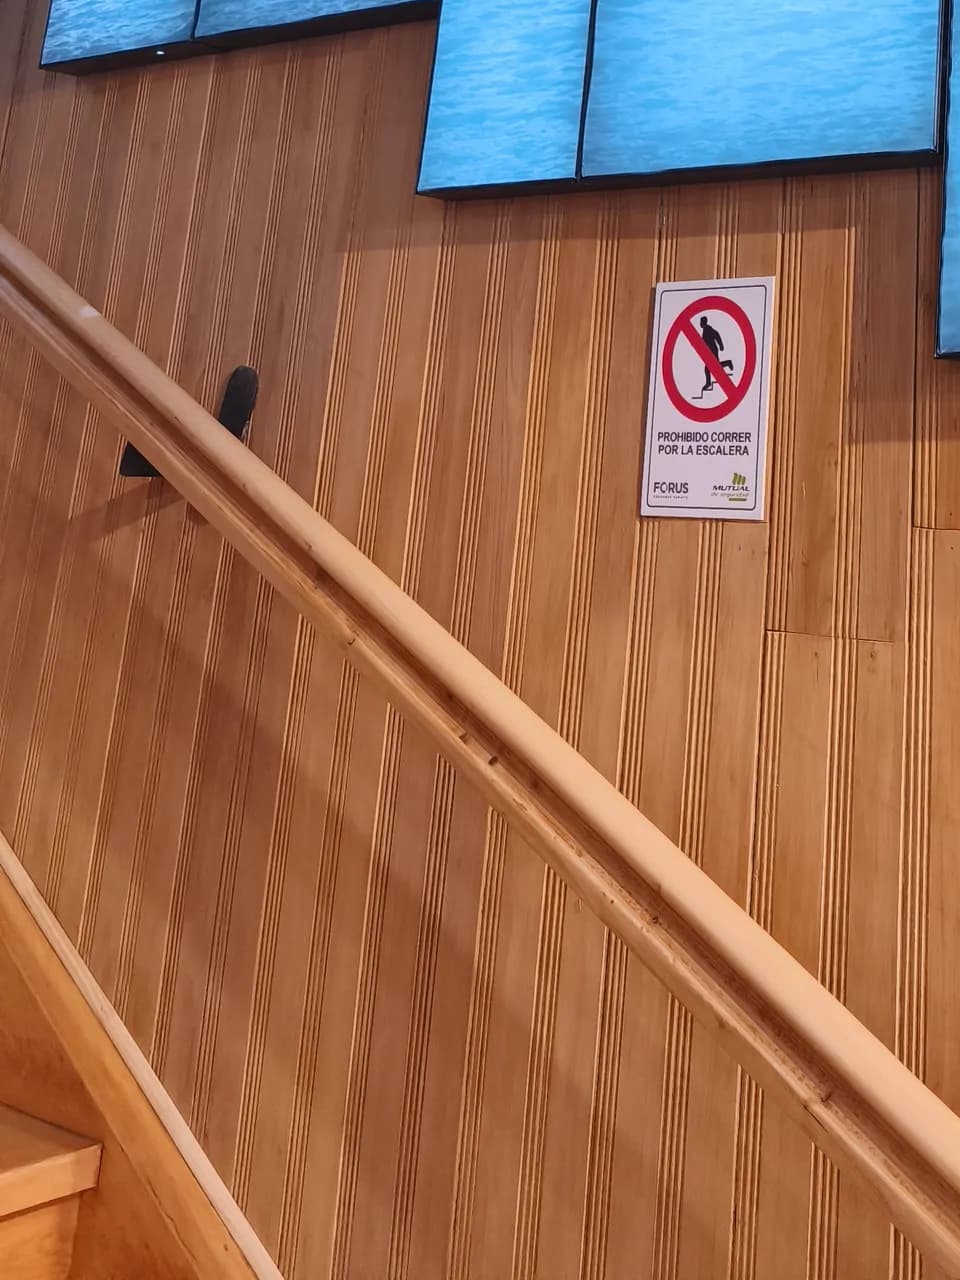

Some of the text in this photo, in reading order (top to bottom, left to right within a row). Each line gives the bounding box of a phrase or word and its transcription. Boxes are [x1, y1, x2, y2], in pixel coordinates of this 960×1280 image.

[657, 431, 751, 442] PROHIBIDO CORRER
[658, 444, 749, 456] POR LA ESCALERA
[653, 481, 689, 494] FORUS
